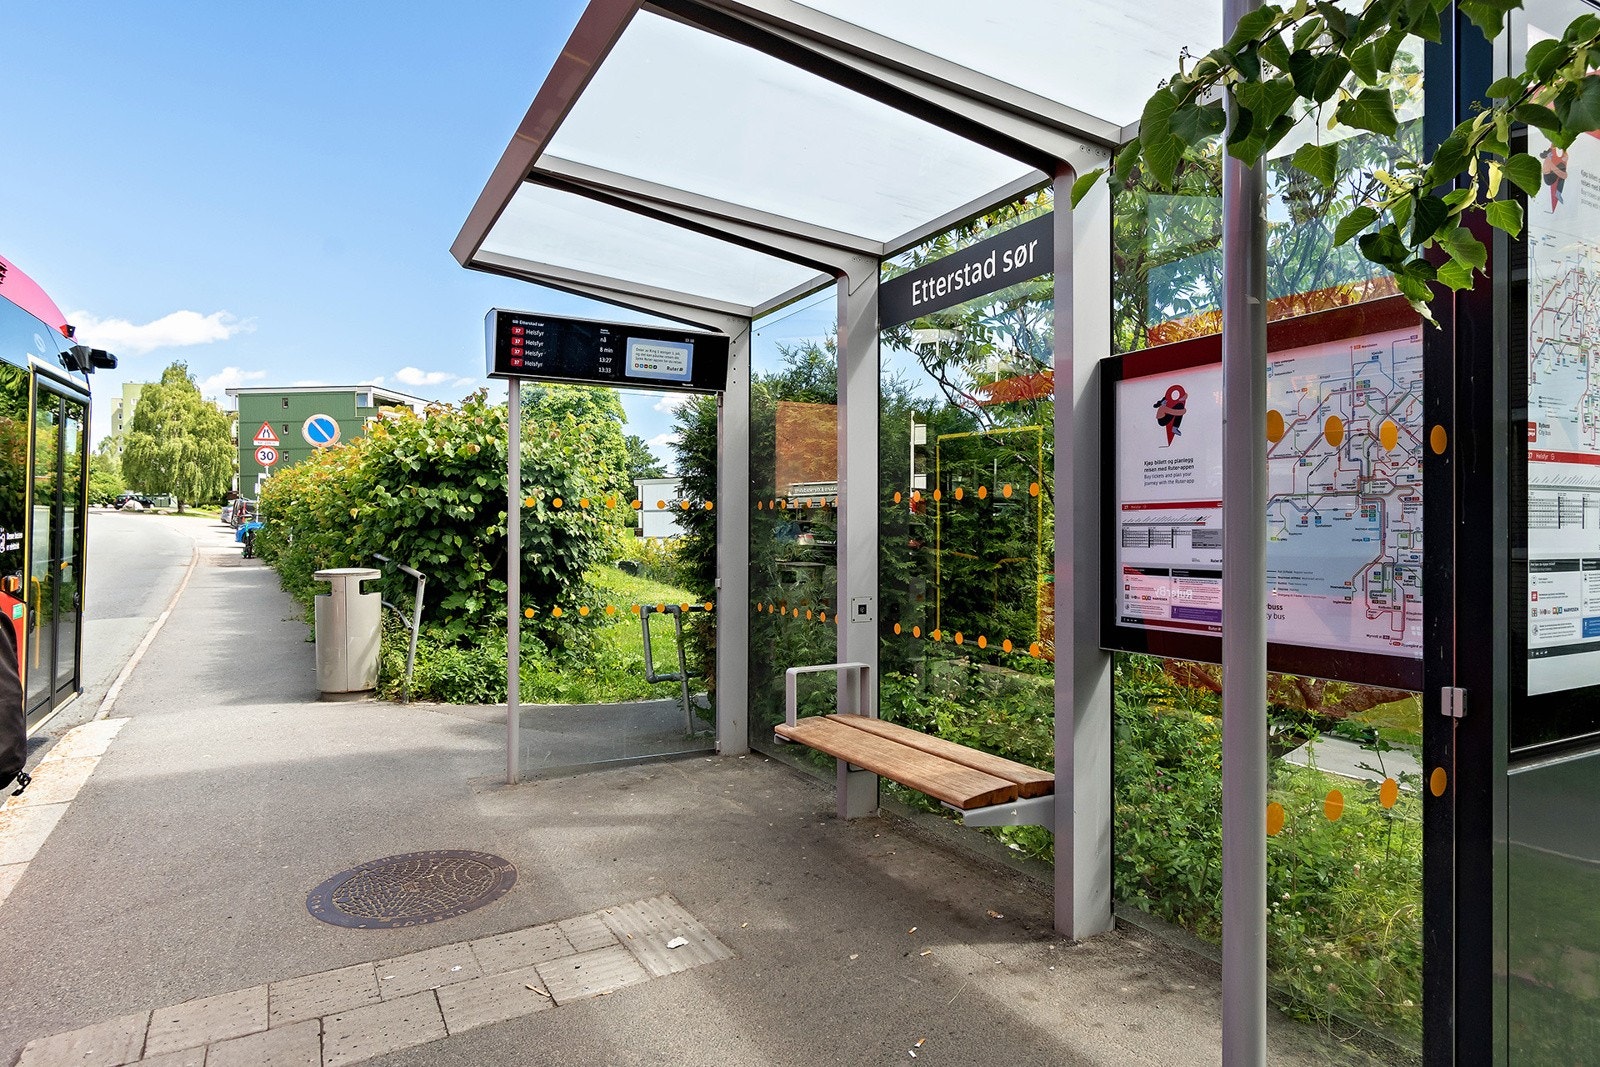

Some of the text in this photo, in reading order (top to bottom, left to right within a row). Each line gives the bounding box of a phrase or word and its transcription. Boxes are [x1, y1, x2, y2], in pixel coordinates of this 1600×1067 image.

[912, 239, 1038, 306] Etterstad sør
[525, 329, 545, 337] Helsfyr
[525, 339, 544, 347] Helsfyr
[524, 360, 543, 368] Helsfyr
[260, 451, 274, 460] 30
[1266, 603, 1284, 611] buss
[1273, 612, 1286, 620] bus
